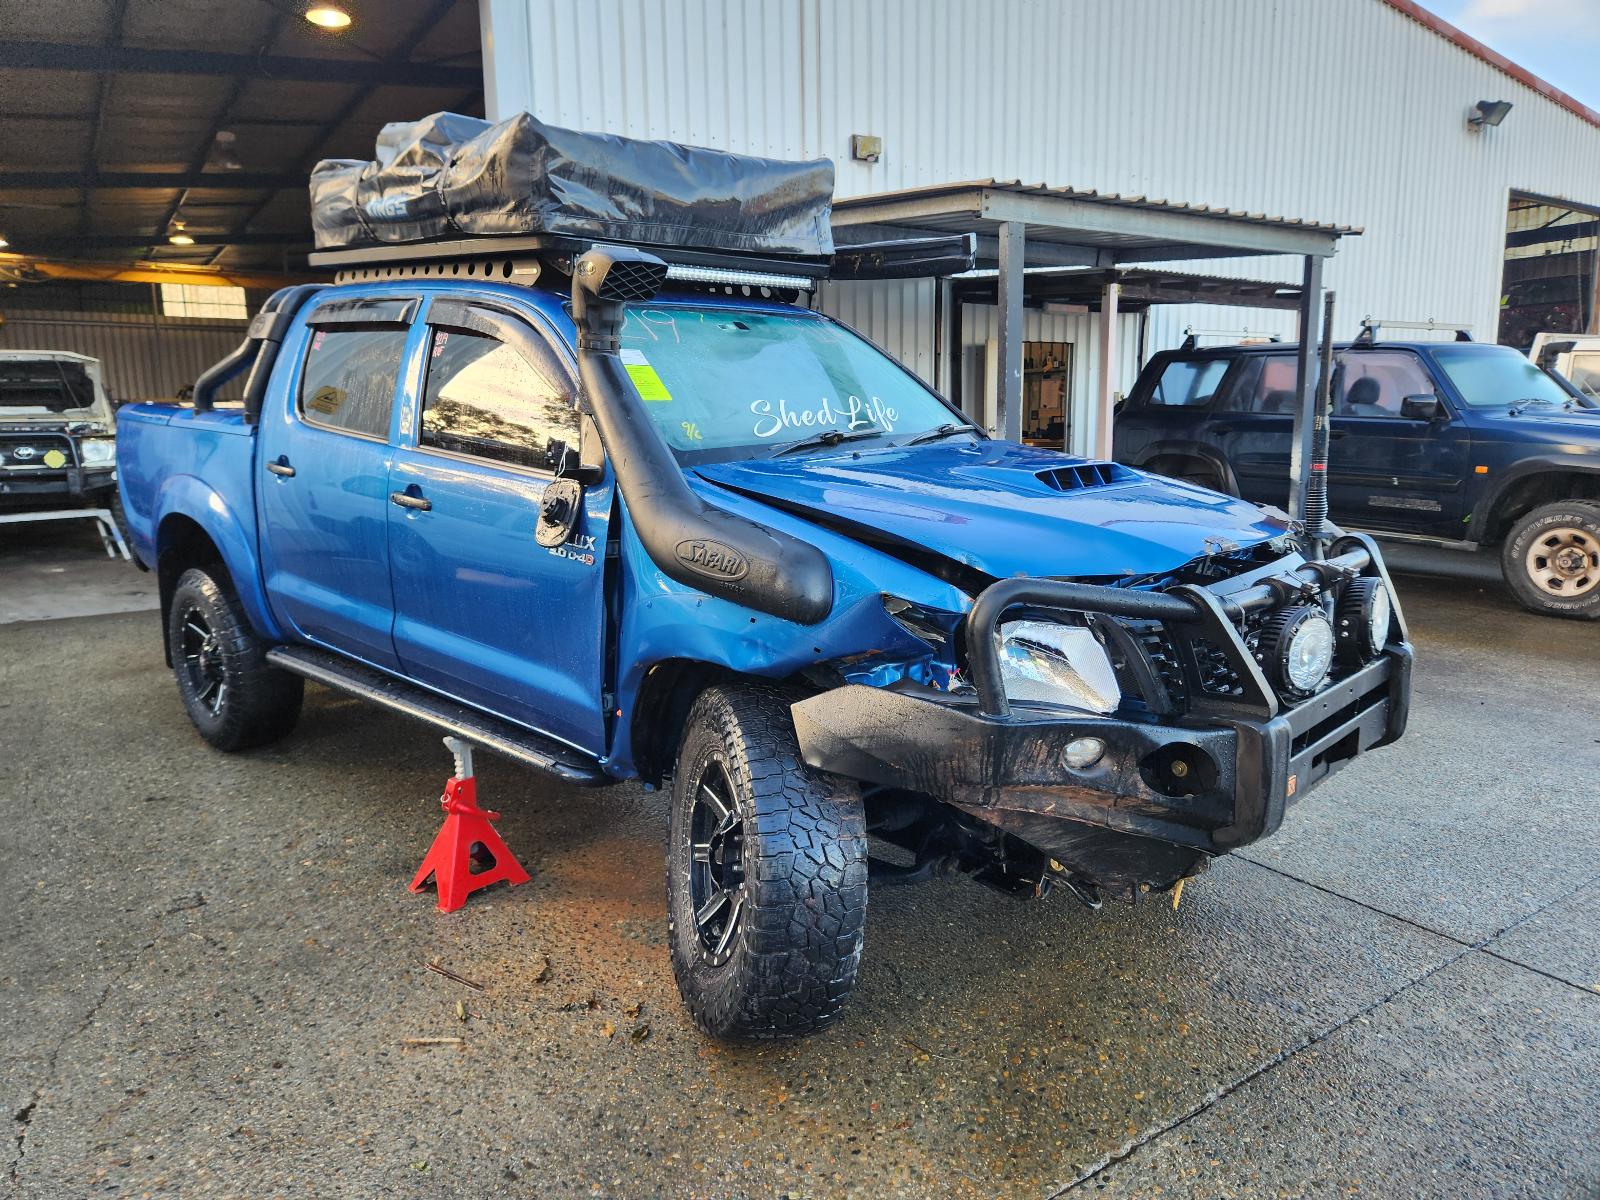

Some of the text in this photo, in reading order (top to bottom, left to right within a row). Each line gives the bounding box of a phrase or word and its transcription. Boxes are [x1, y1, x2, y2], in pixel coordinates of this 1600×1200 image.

[750, 395, 899, 438] Shed Life
[680, 541, 742, 575] SAFARI
